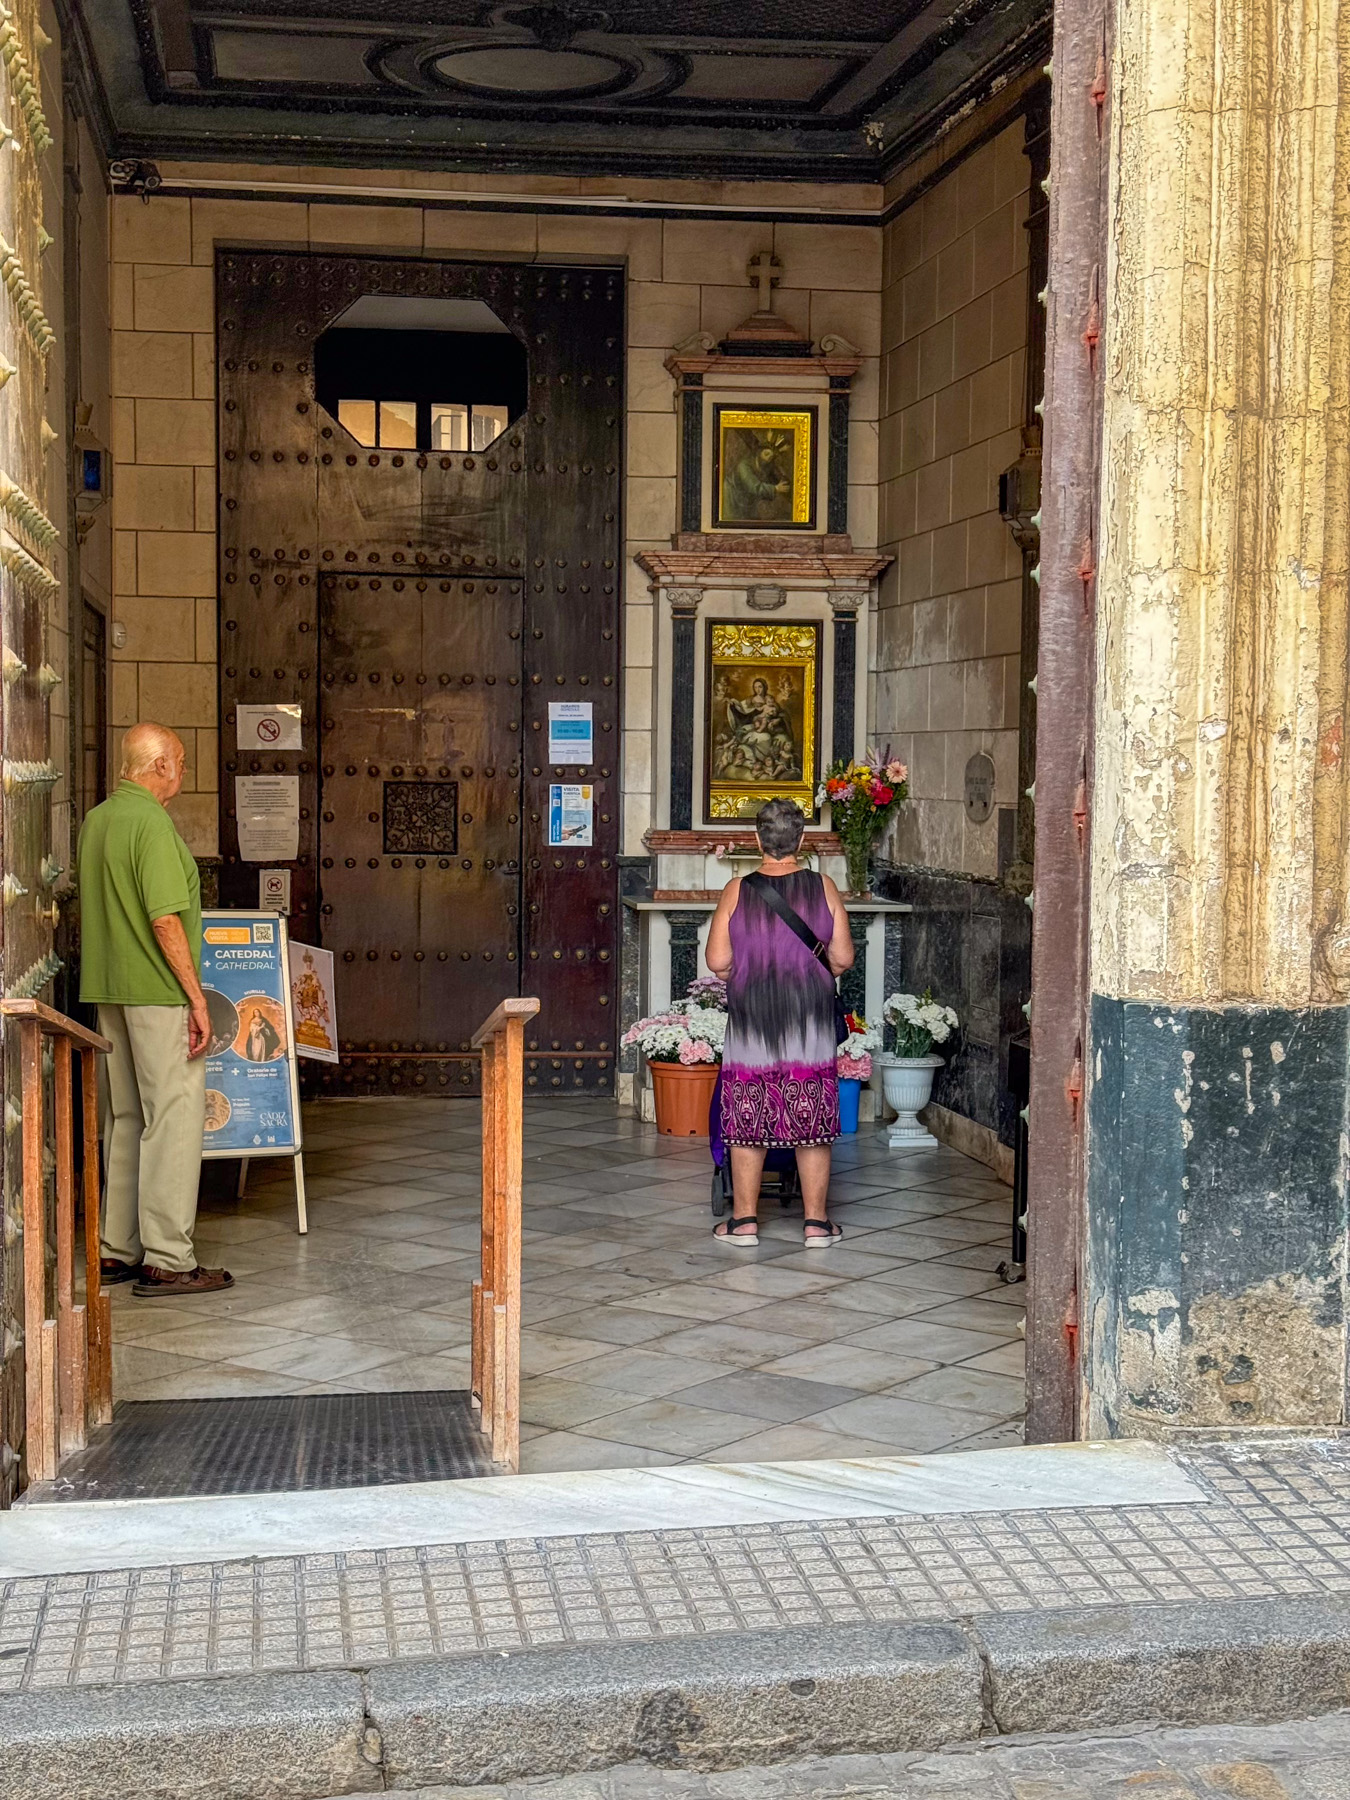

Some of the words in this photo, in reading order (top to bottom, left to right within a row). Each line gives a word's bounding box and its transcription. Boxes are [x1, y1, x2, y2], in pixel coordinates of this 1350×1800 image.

[214, 949, 276, 959] CATEDRAL
[215, 961, 276, 970] CATHEDRAL
[259, 1119, 288, 1127] SACRA
